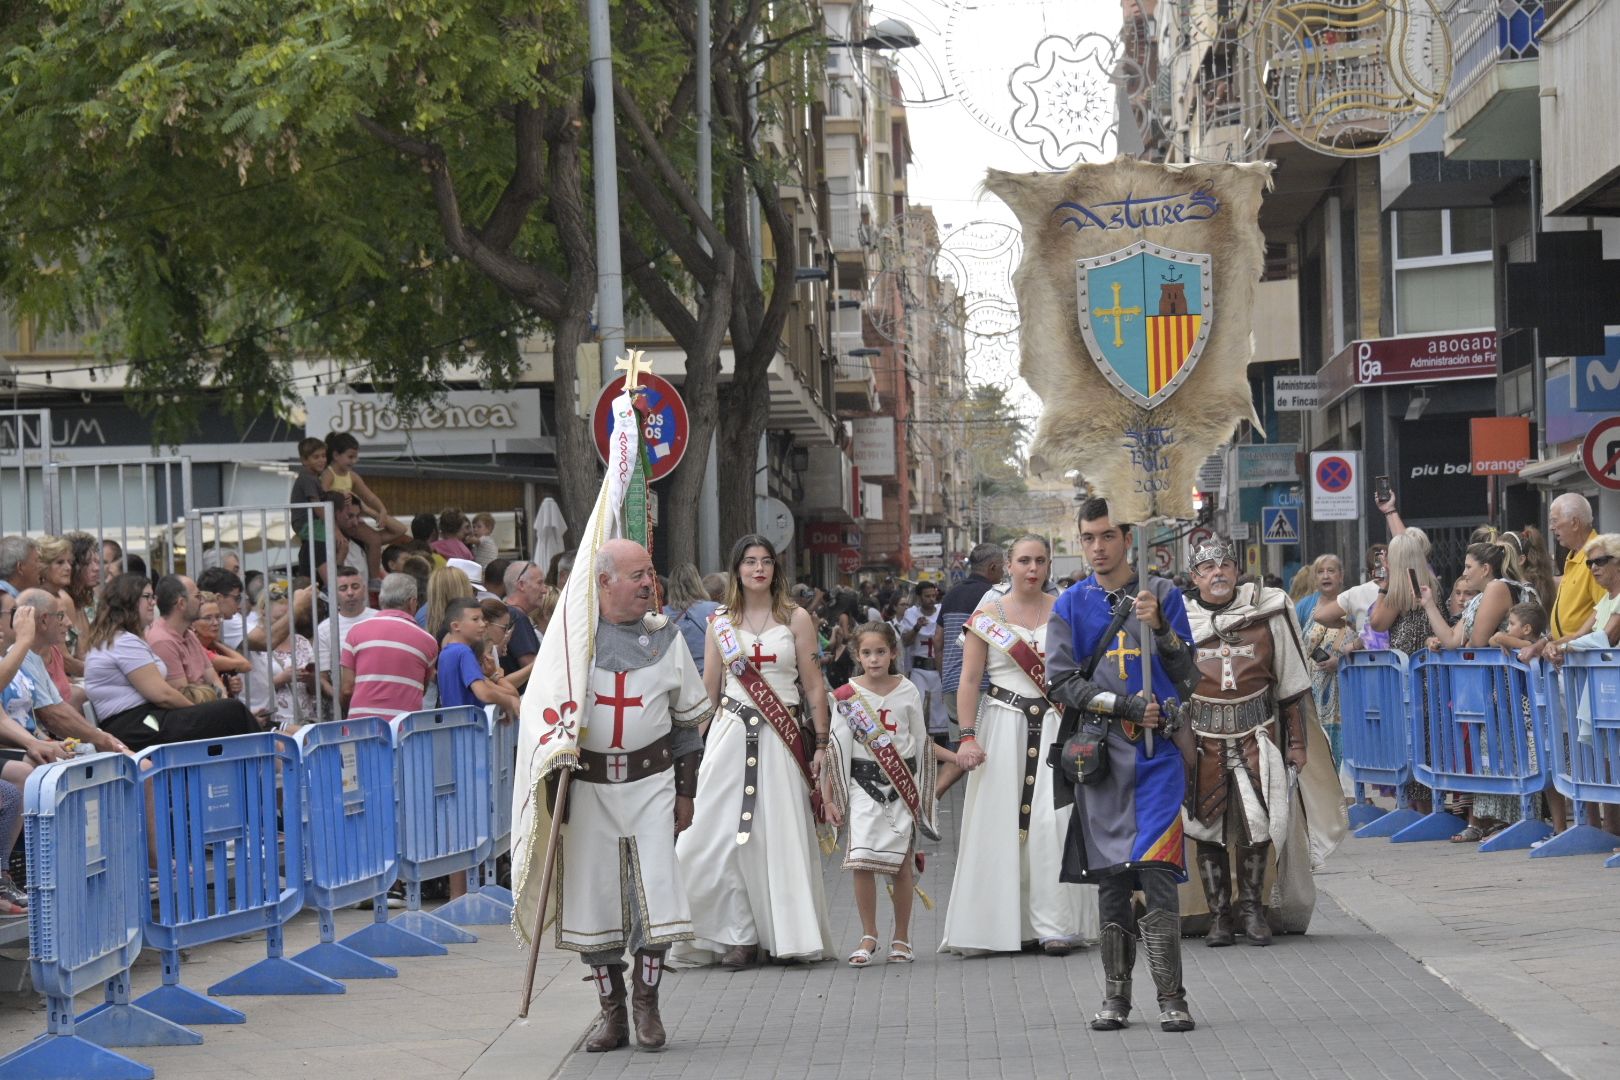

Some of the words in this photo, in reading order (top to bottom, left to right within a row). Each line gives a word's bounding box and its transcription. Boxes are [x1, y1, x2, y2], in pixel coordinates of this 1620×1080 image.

[1410, 353, 1470, 368] Administración
[1472, 352, 1483, 363] de
[1277, 396, 1287, 406] de
[1292, 396, 1318, 406] Fincas
[1410, 464, 1440, 479] piu
[1475, 460, 1525, 473] orange
[750, 681, 798, 745] CAPITANA
[879, 748, 917, 805] CAPITANA
